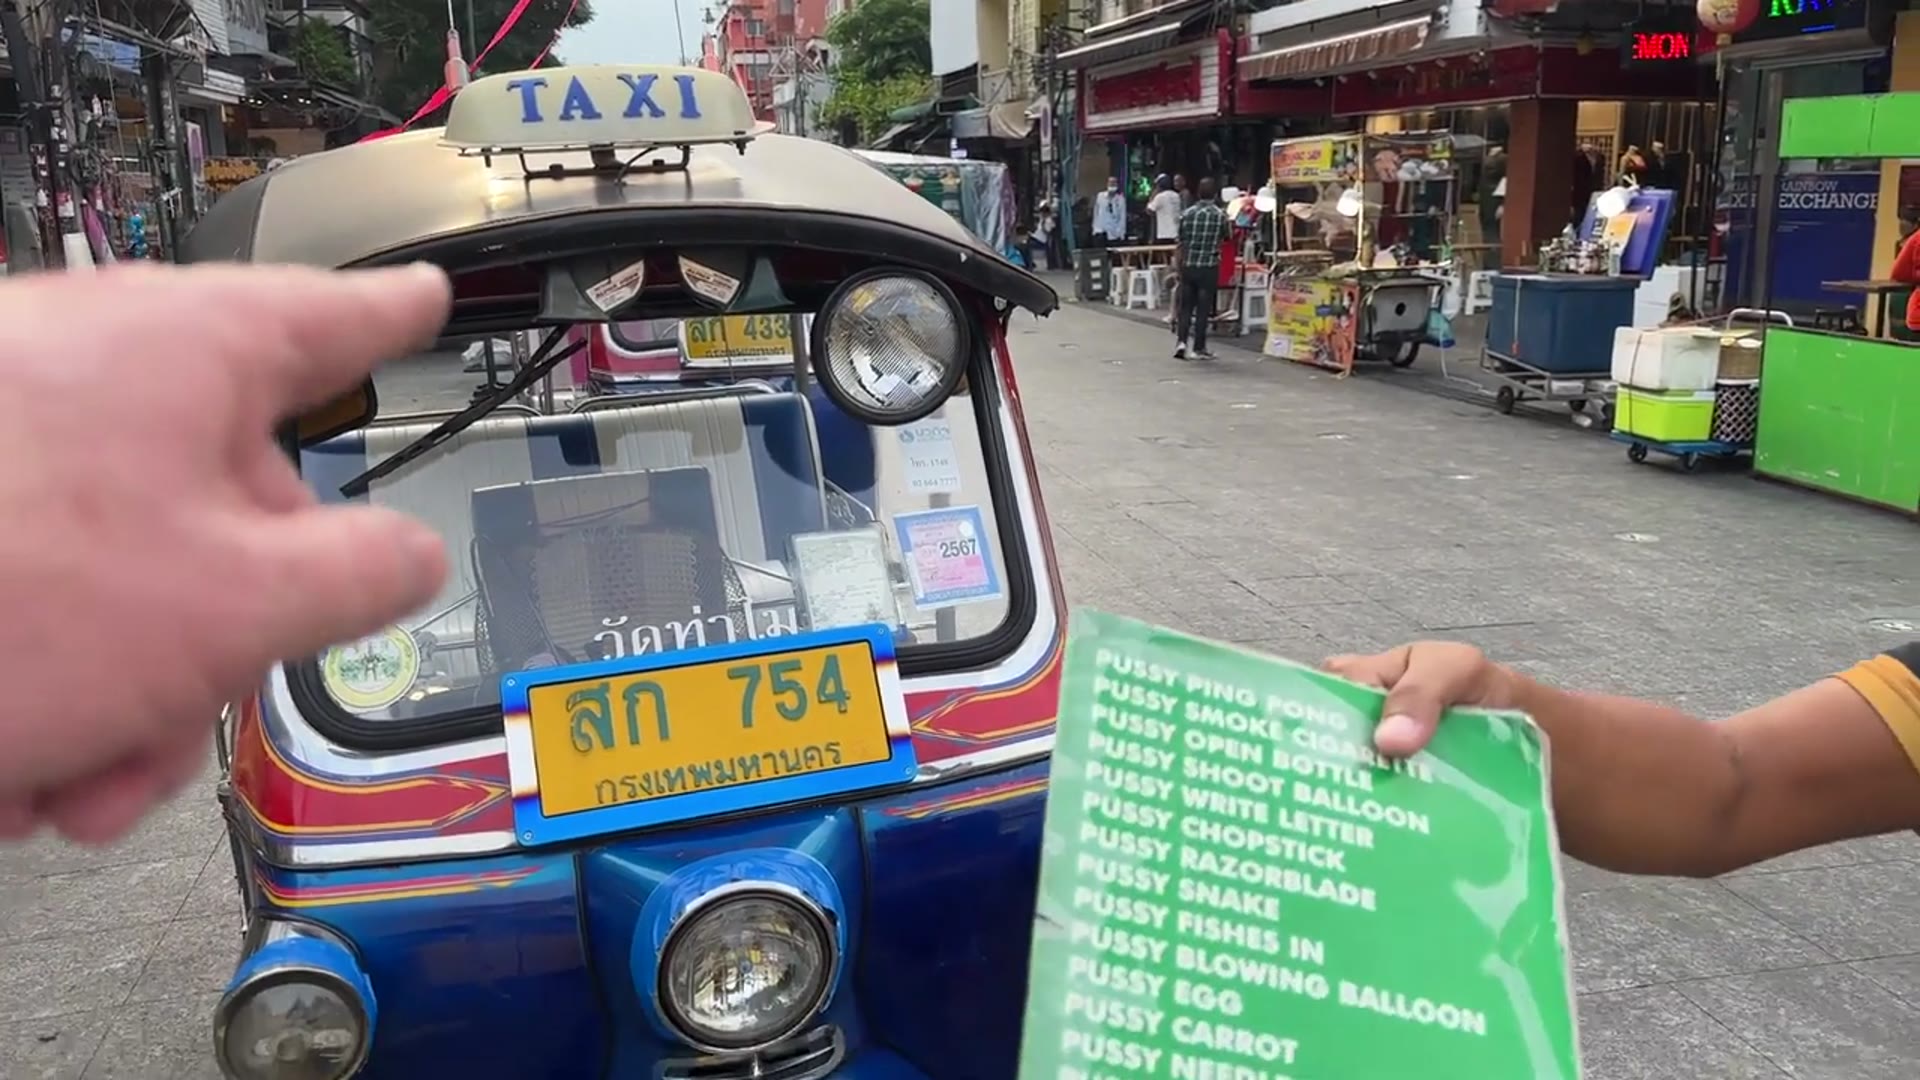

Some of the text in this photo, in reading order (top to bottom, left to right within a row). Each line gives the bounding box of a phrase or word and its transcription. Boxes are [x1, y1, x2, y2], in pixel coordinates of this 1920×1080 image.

[506, 73, 702, 123] TAXI
[938, 538, 977, 559] 2567
[567, 654, 850, 753] สก 754
[1093, 675, 1178, 714] PUSSY
[1184, 700, 1283, 741] SMOKE
[1095, 648, 1348, 730] PUSSY PING PONG
[594, 741, 842, 804] กรงเทพมหานคร
[1087, 729, 1431, 834] PUSSY SHOOT BALLOON
[1090, 703, 1374, 792] PUSSY OPEN BOTTLE
[1082, 790, 1346, 872] PUSSY CHOPSTICK
[1085, 760, 1375, 849] PUSSY WRITE LETTER
[1076, 851, 1280, 922] PUSSY SNAKE
[1079, 820, 1377, 912] PUSSY RAZORBLADE
[1073, 886, 1325, 966] PUSSY FISHES IN
[1068, 954, 1243, 1016] PUSSY EGG
[1071, 919, 1487, 1036] PUSSY BLOWING BALLOON
[1061, 1028, 1162, 1074] PUSSY
[1064, 991, 1299, 1064] PUSSY CARROT
